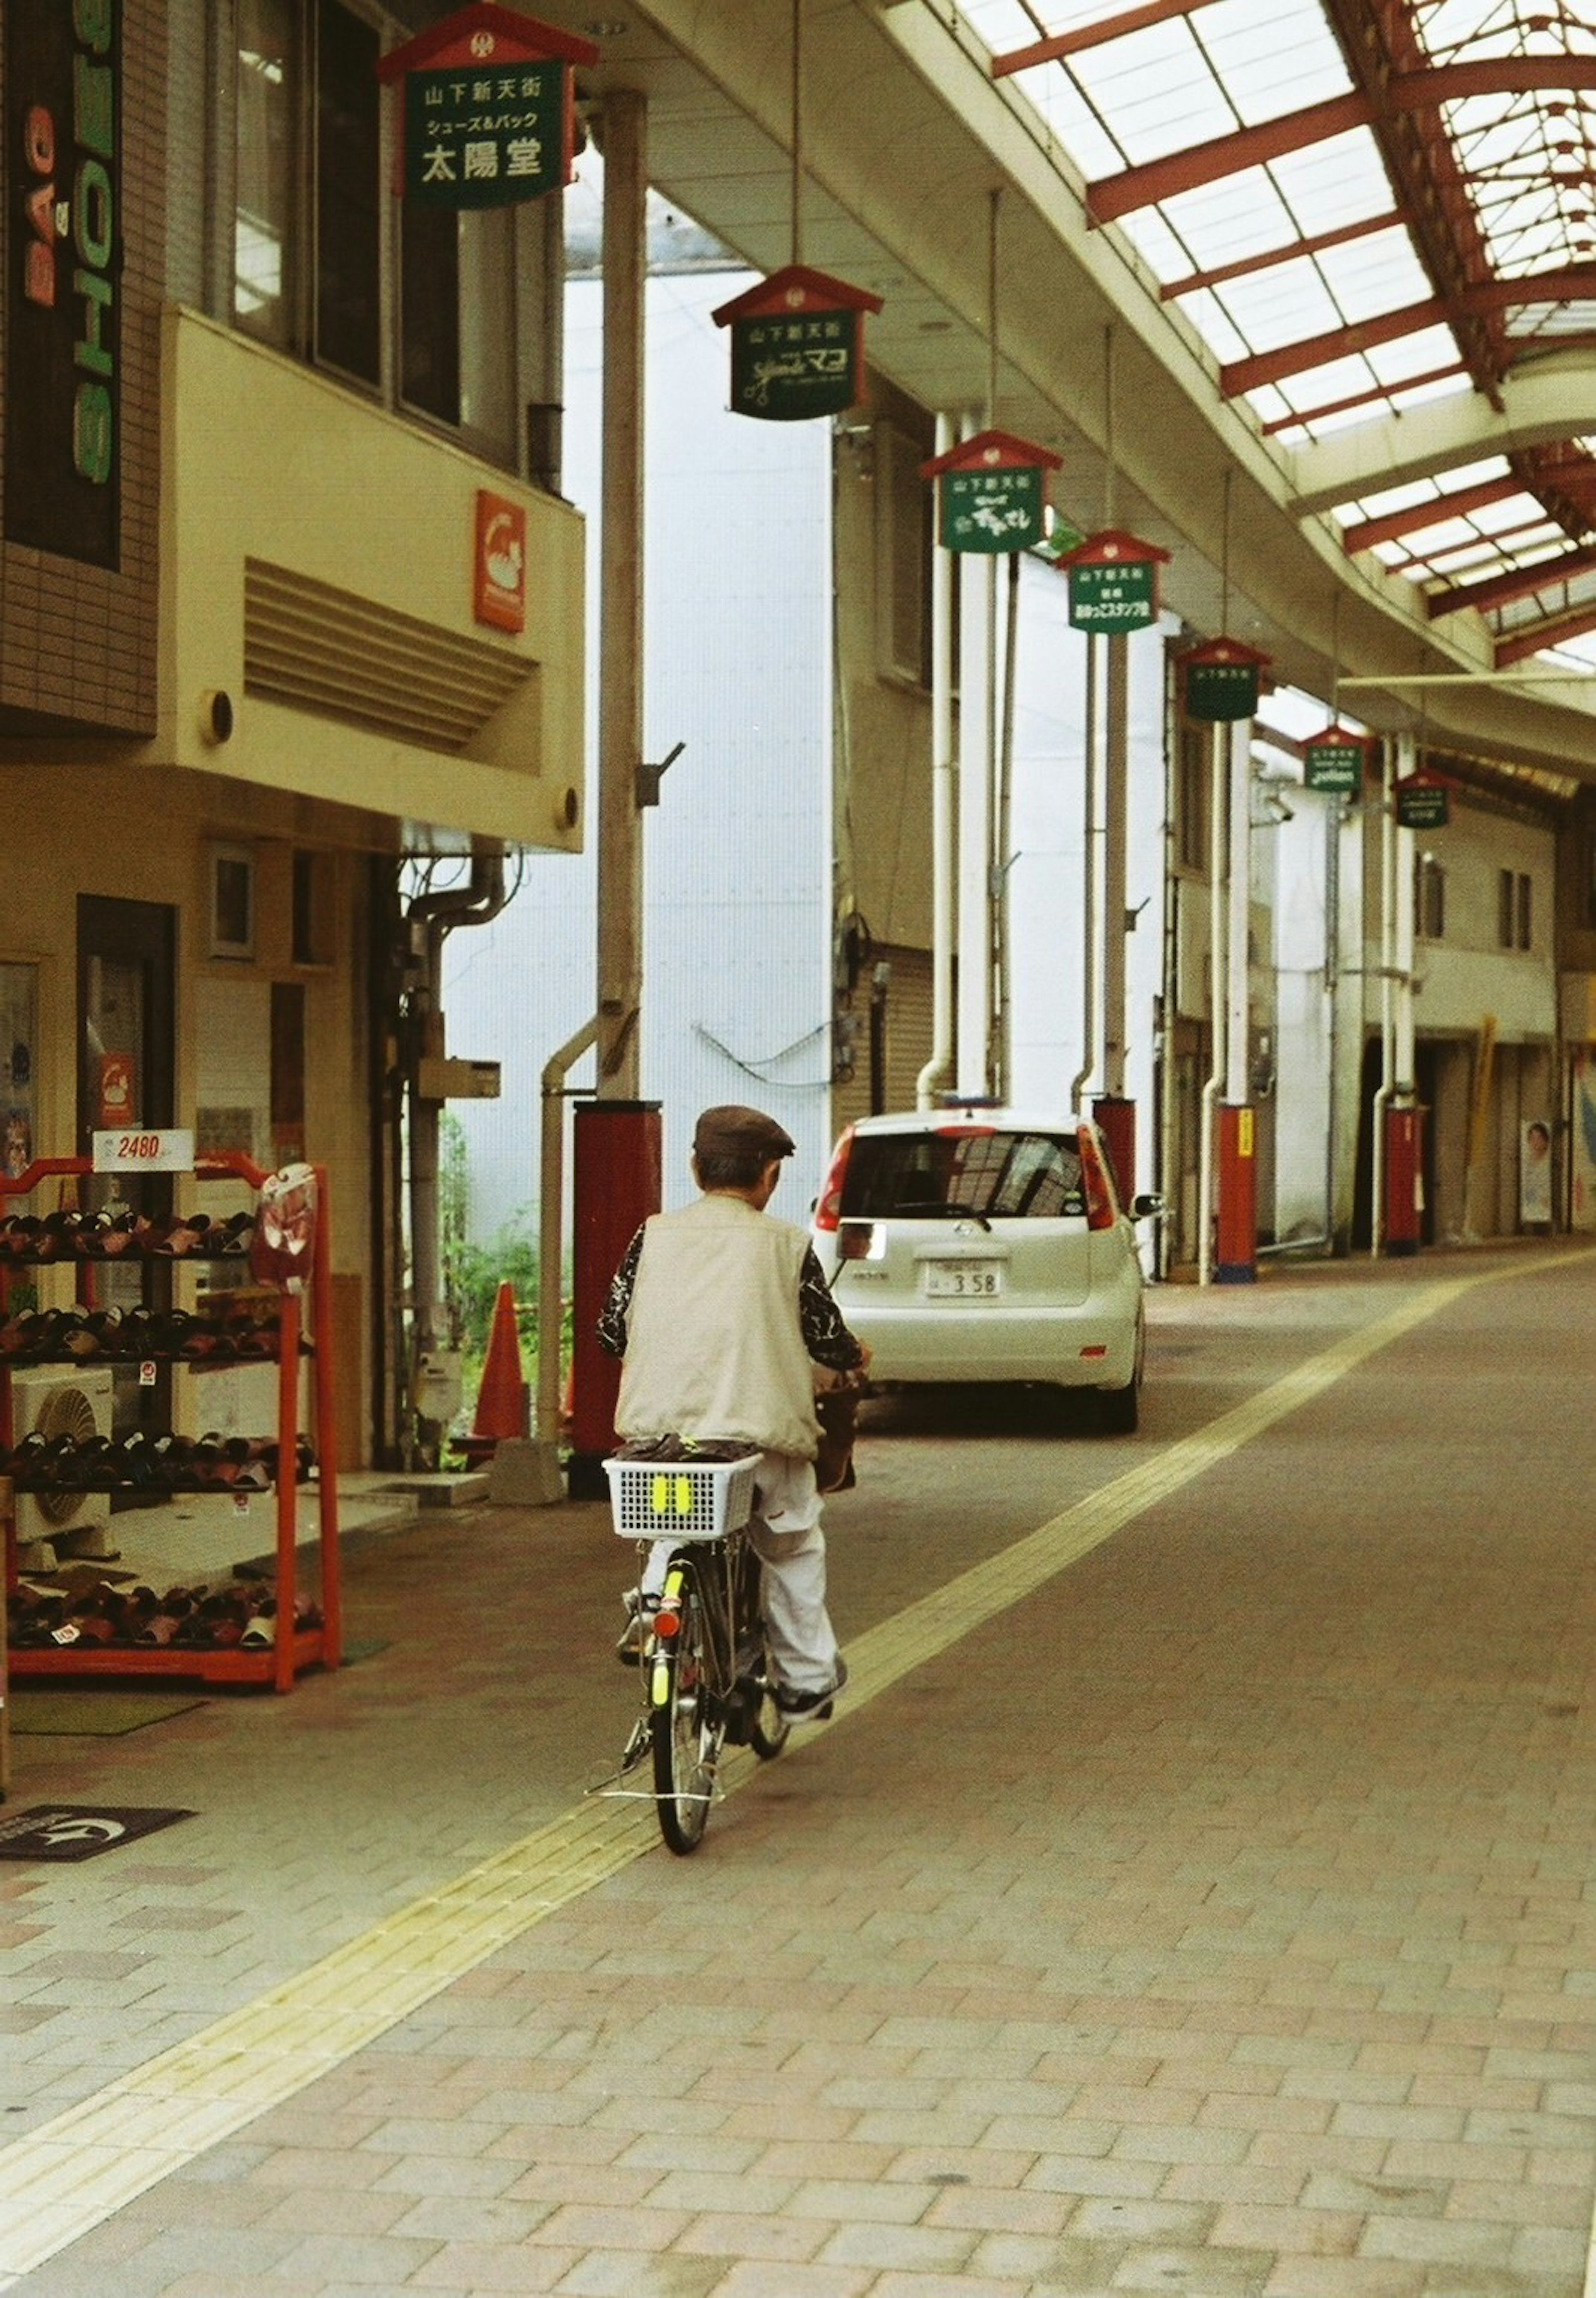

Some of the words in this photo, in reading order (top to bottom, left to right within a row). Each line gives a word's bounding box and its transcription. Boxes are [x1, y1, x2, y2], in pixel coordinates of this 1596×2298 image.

[425, 76, 541, 106] 山下新天街
[422, 137, 541, 182] 太陽堂
[118, 1136, 159, 1158] 2480
